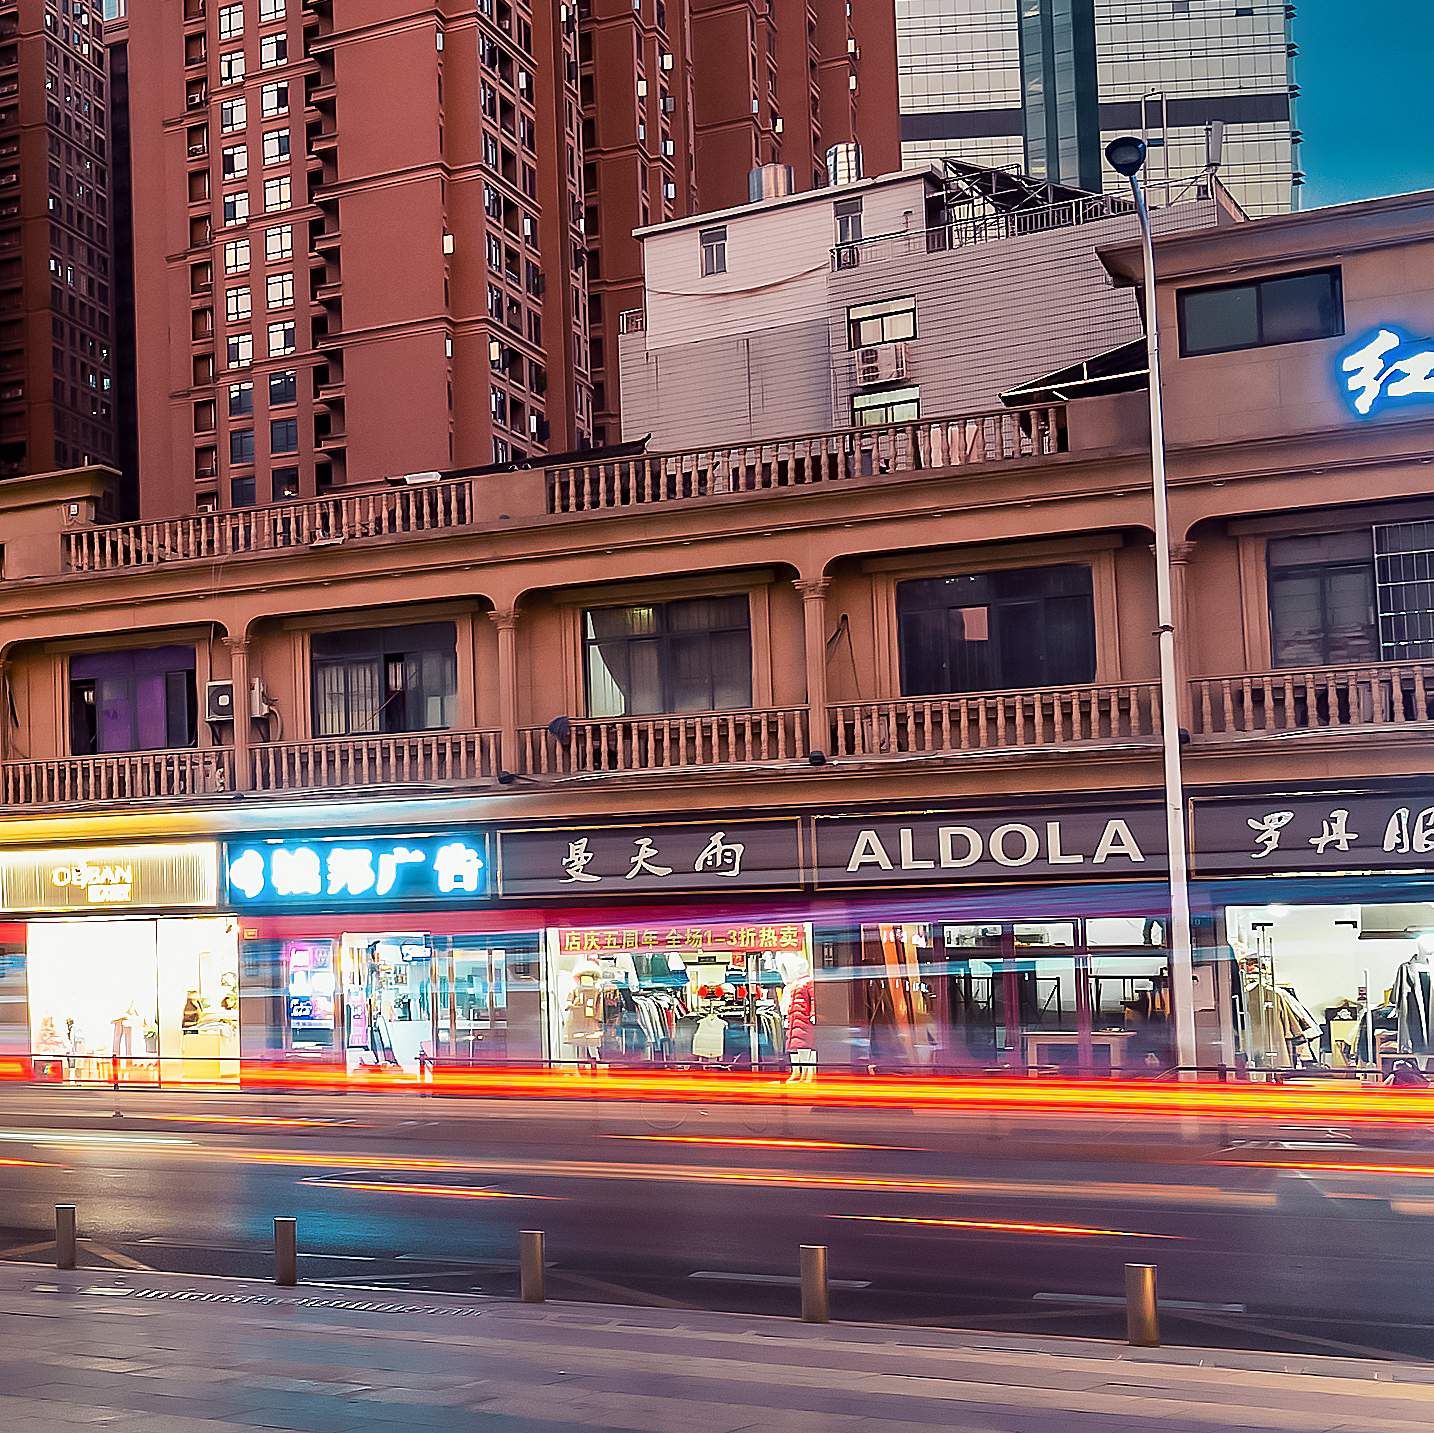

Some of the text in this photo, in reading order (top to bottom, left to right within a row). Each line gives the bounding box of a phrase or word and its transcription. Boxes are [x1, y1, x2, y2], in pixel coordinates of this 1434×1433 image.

[559, 831, 745, 884] 曼天雨
[846, 818, 1146, 872] ALDOLA
[564, 929, 660, 952] 店庆五周年
